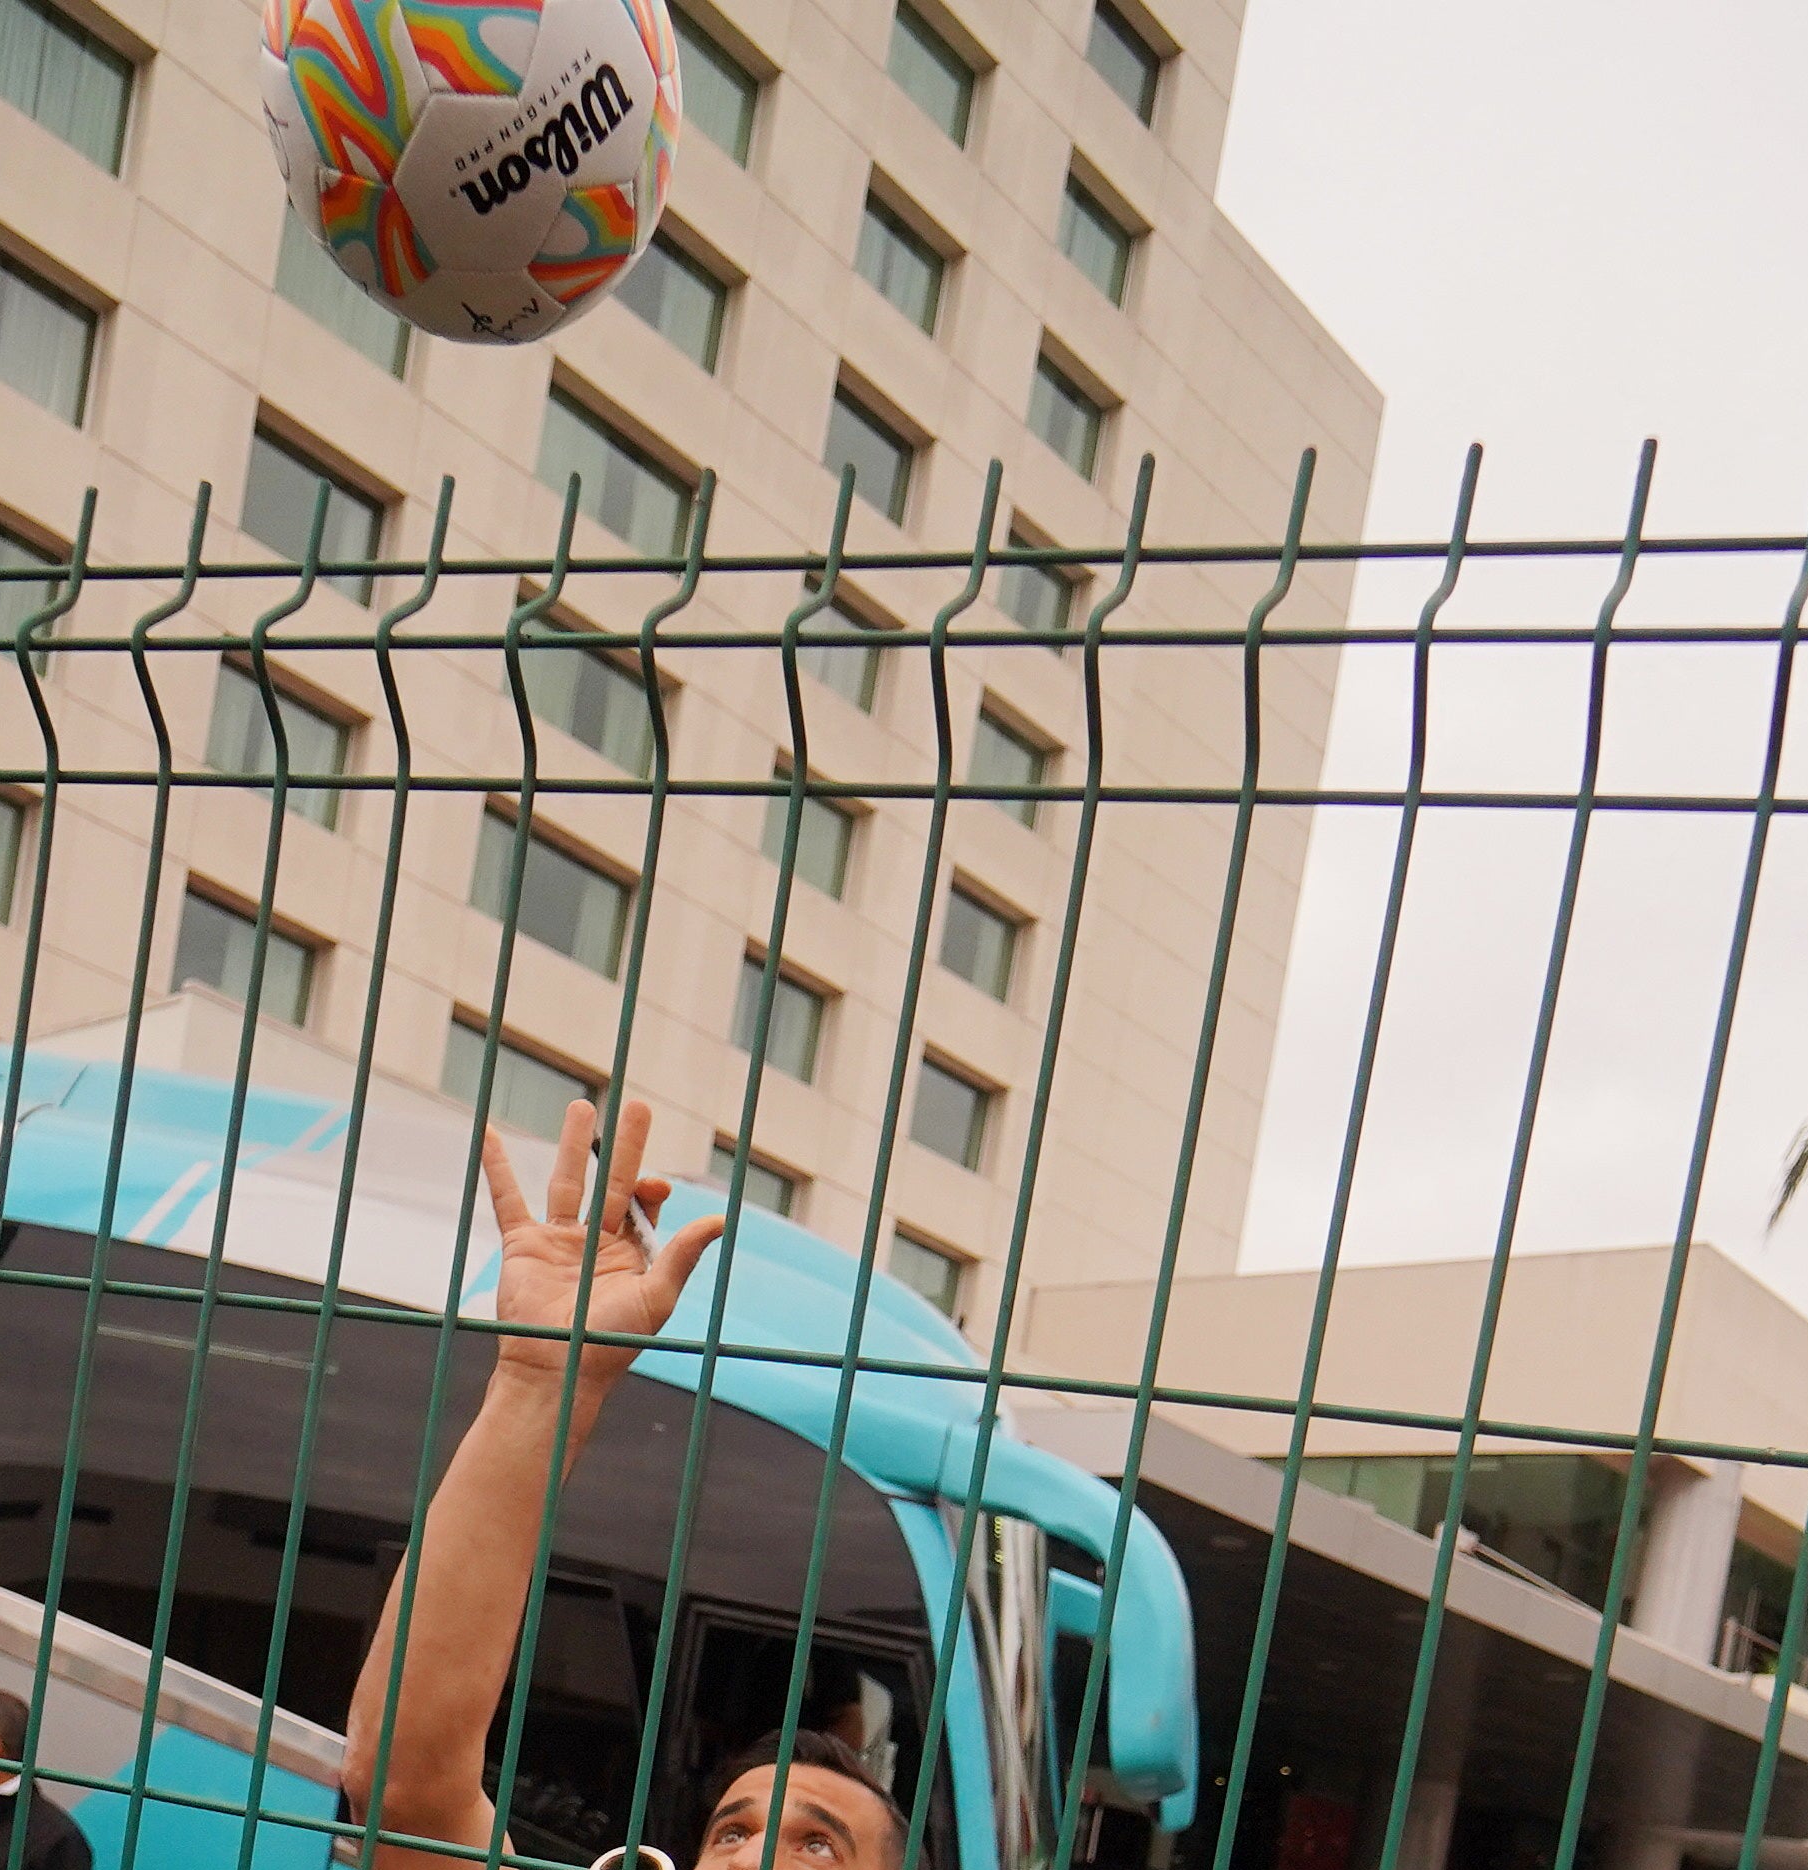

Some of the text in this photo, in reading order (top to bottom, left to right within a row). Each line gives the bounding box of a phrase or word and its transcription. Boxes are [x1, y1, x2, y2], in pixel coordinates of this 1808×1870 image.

[455, 47, 592, 172] PENTAGON PRO
[460, 63, 633, 216] Wilson
